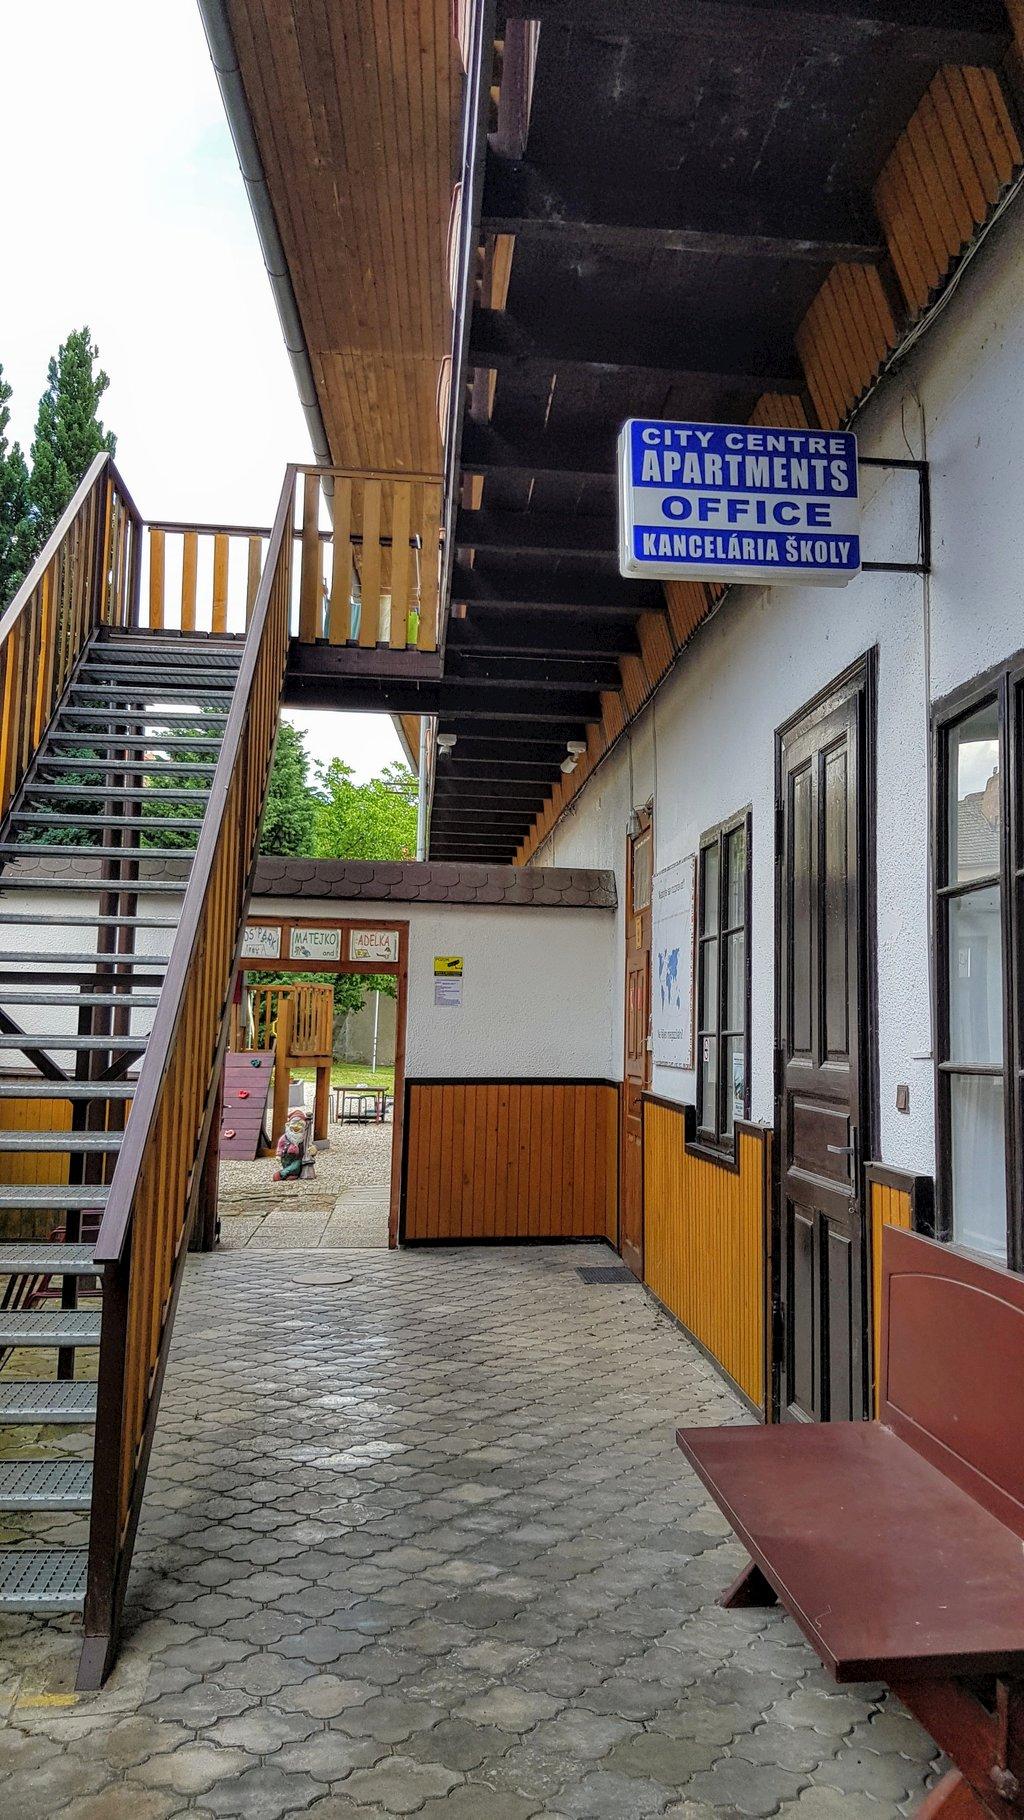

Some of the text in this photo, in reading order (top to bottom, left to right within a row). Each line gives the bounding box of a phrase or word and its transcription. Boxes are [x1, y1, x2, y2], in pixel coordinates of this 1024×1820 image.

[641, 428, 846, 455] CITY CENTRE
[641, 450, 849, 492] APARTMENTS
[661, 495, 832, 527] OFFICE
[642, 533, 851, 564] KANCELÁRIA ŠKOLY
[294, 931, 337, 945] MATEJKO
[357, 934, 391, 947] ADELKA
